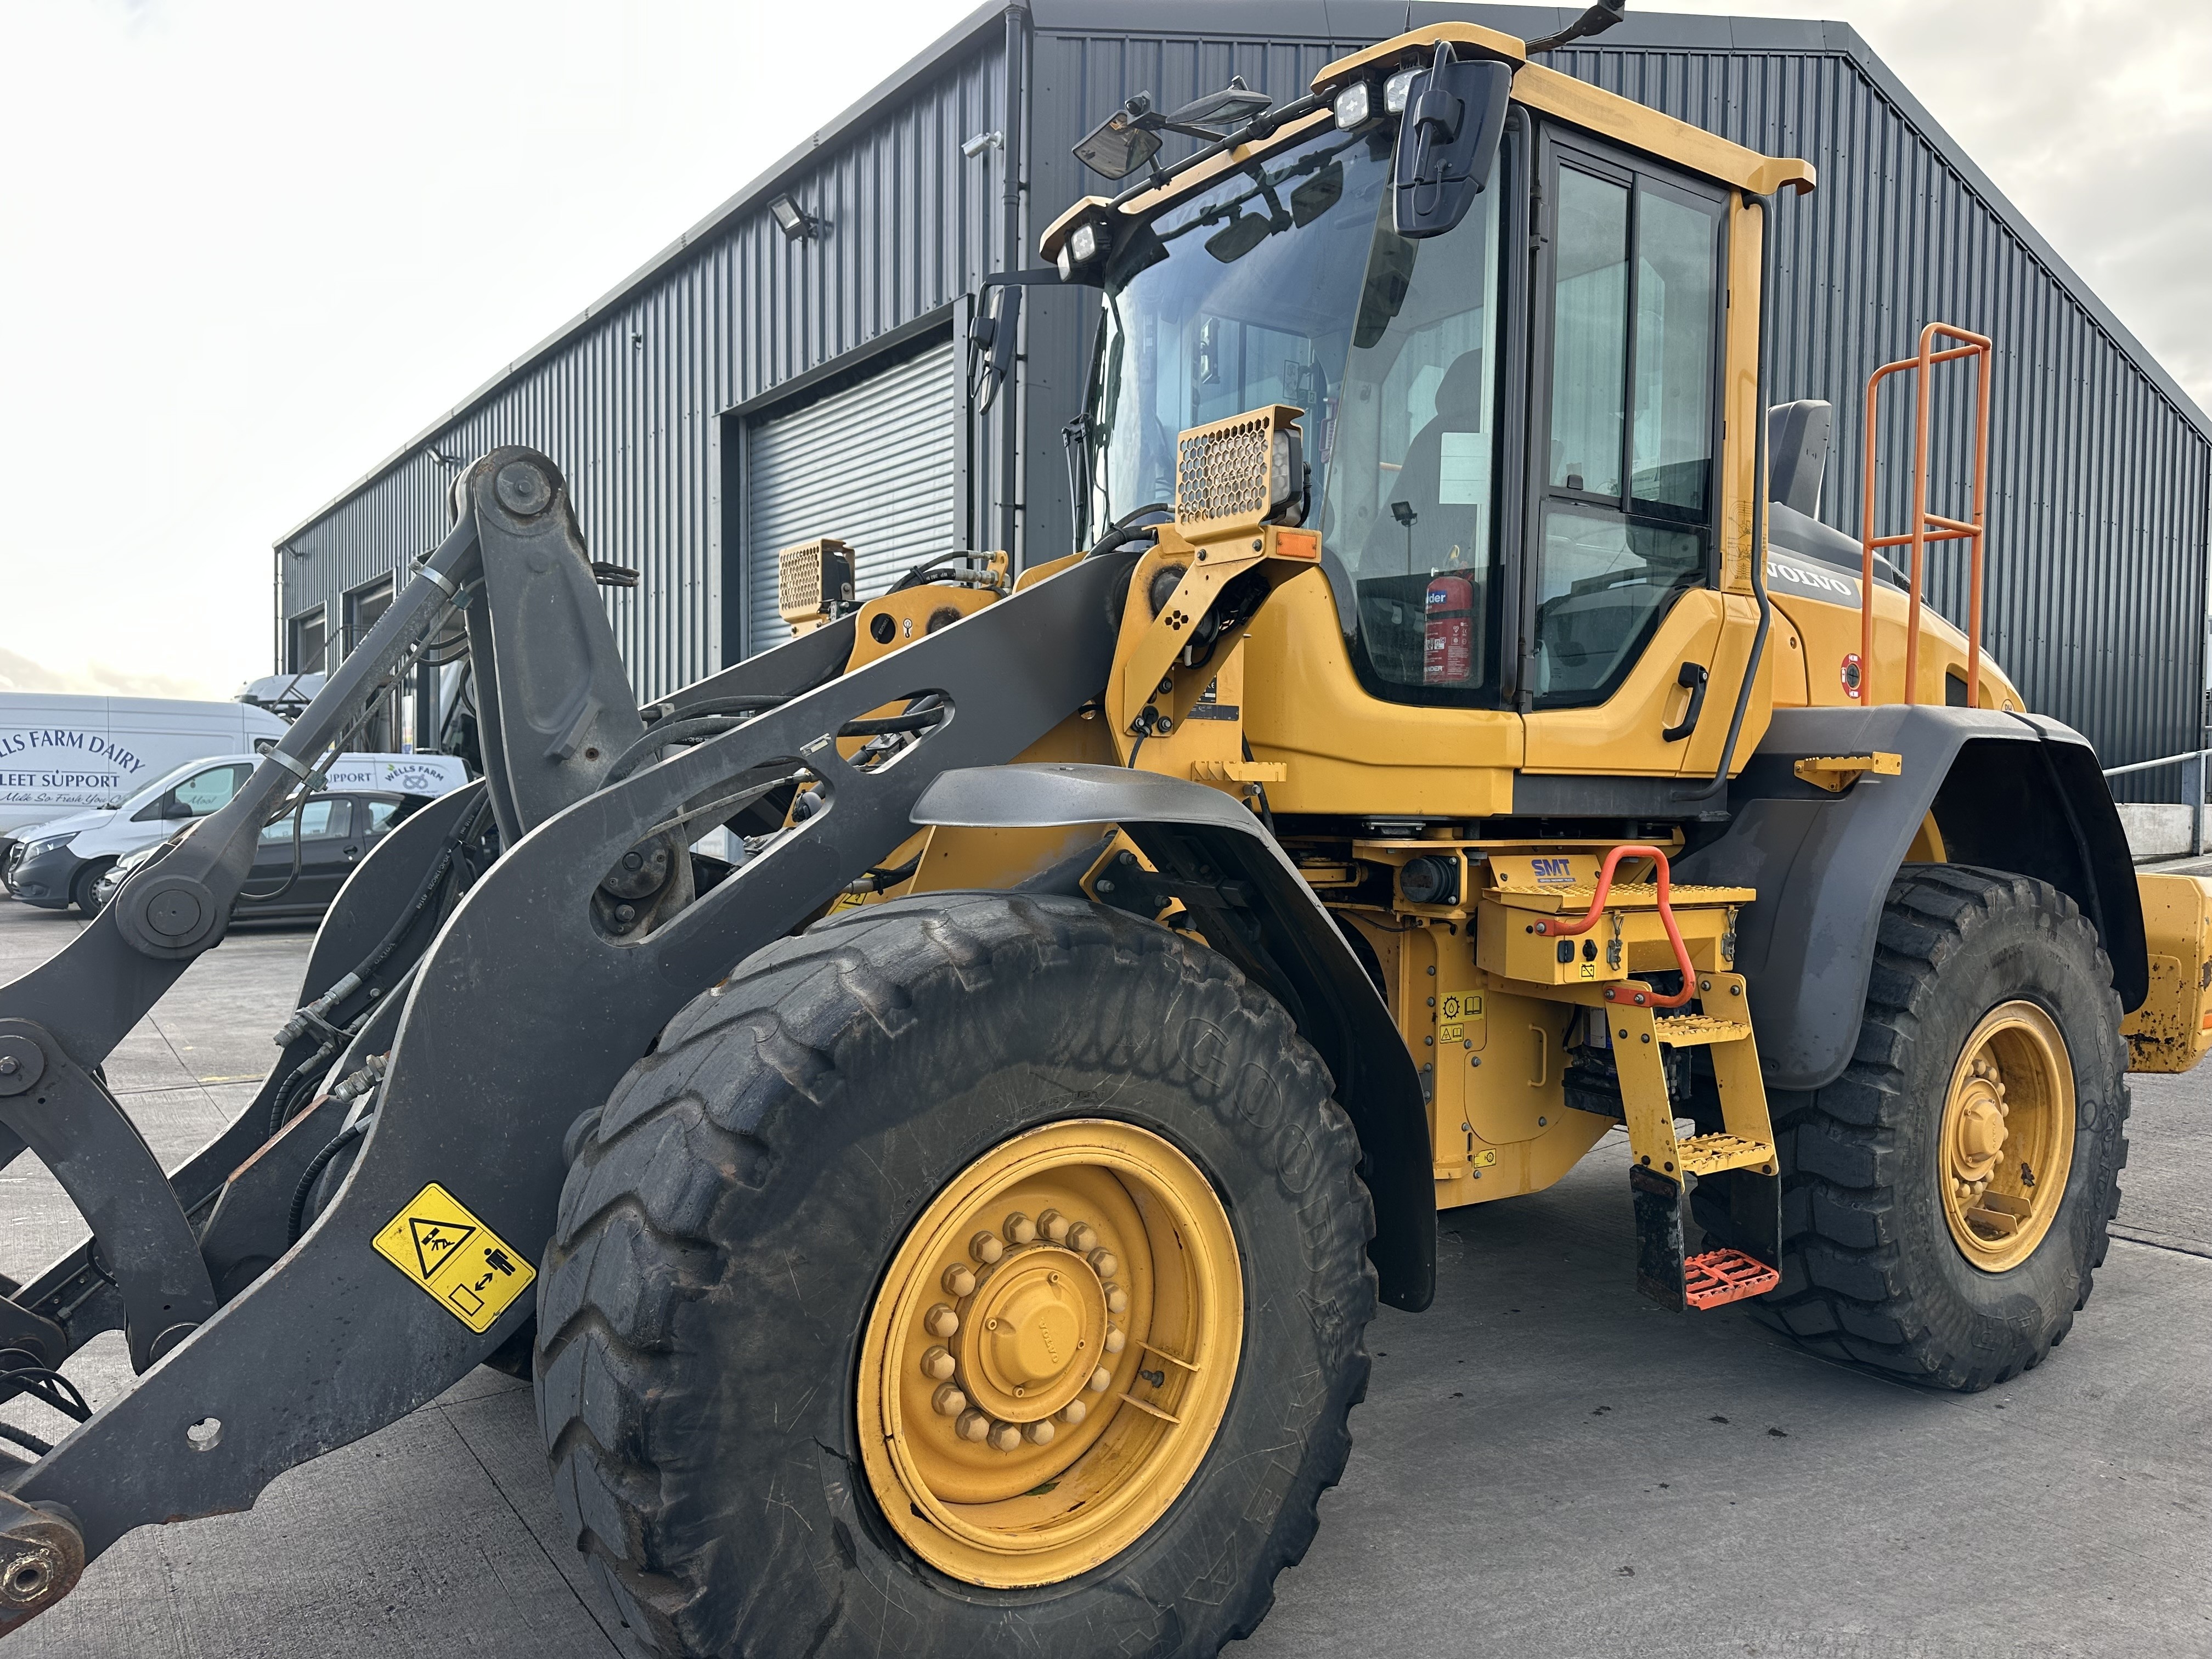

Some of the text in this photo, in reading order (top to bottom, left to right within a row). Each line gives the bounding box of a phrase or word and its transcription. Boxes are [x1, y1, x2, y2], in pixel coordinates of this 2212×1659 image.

[1767, 562, 1852, 596] VOLVO
[1428, 593, 1446, 603] der
[29, 730, 83, 749] FARM
[88, 736, 145, 774] DAIRY
[42, 774, 120, 788] SUPPORT
[328, 772, 371, 783] UPPORT
[385, 765, 444, 782] WELLS FARM
[1, 792, 32, 802] Milk
[34, 793, 53, 803] So
[55, 793, 83, 803] Fresh
[1531, 859, 1570, 876] SMT
[1039, 1317, 1059, 1364] VOLVO
